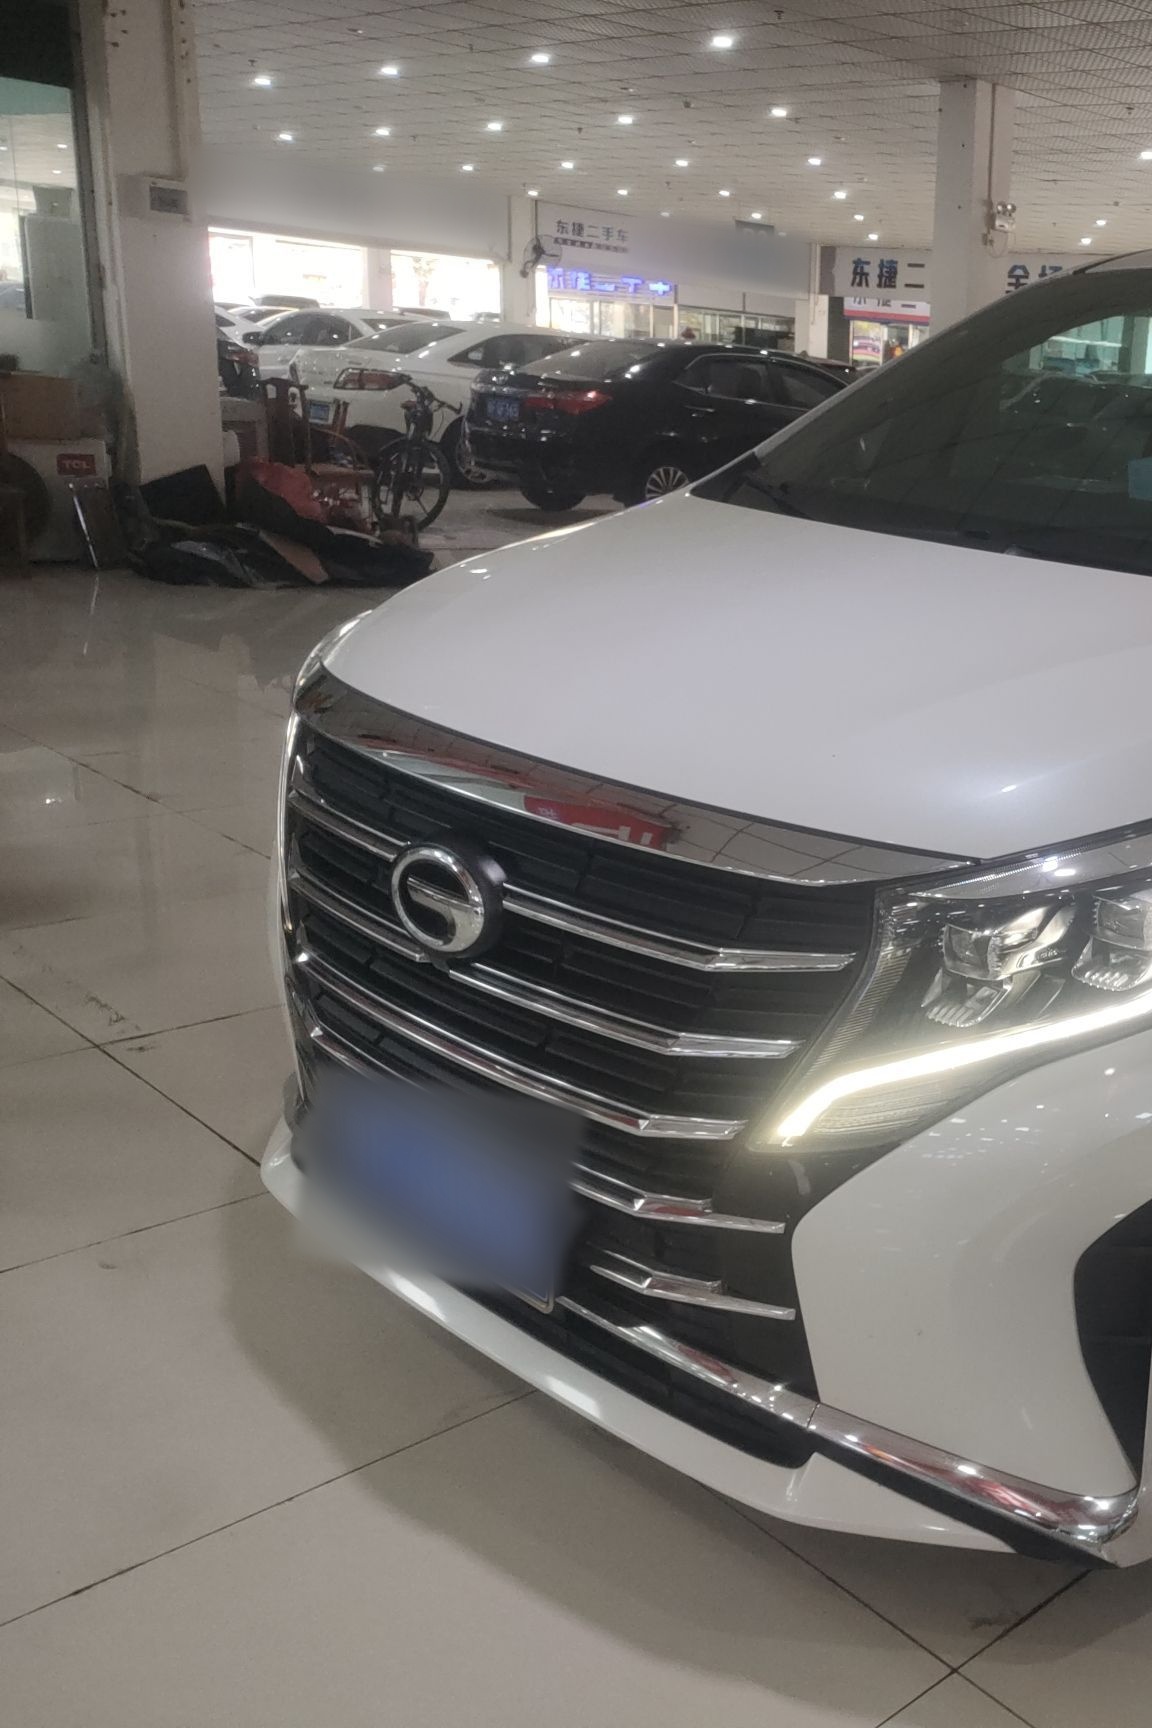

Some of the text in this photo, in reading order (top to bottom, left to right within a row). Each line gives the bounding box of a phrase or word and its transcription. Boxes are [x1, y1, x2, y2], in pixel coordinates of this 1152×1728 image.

[555, 219, 630, 243] 东捷二手车
[850, 257, 926, 289] 东捷二
[61, 459, 91, 469] TCL
